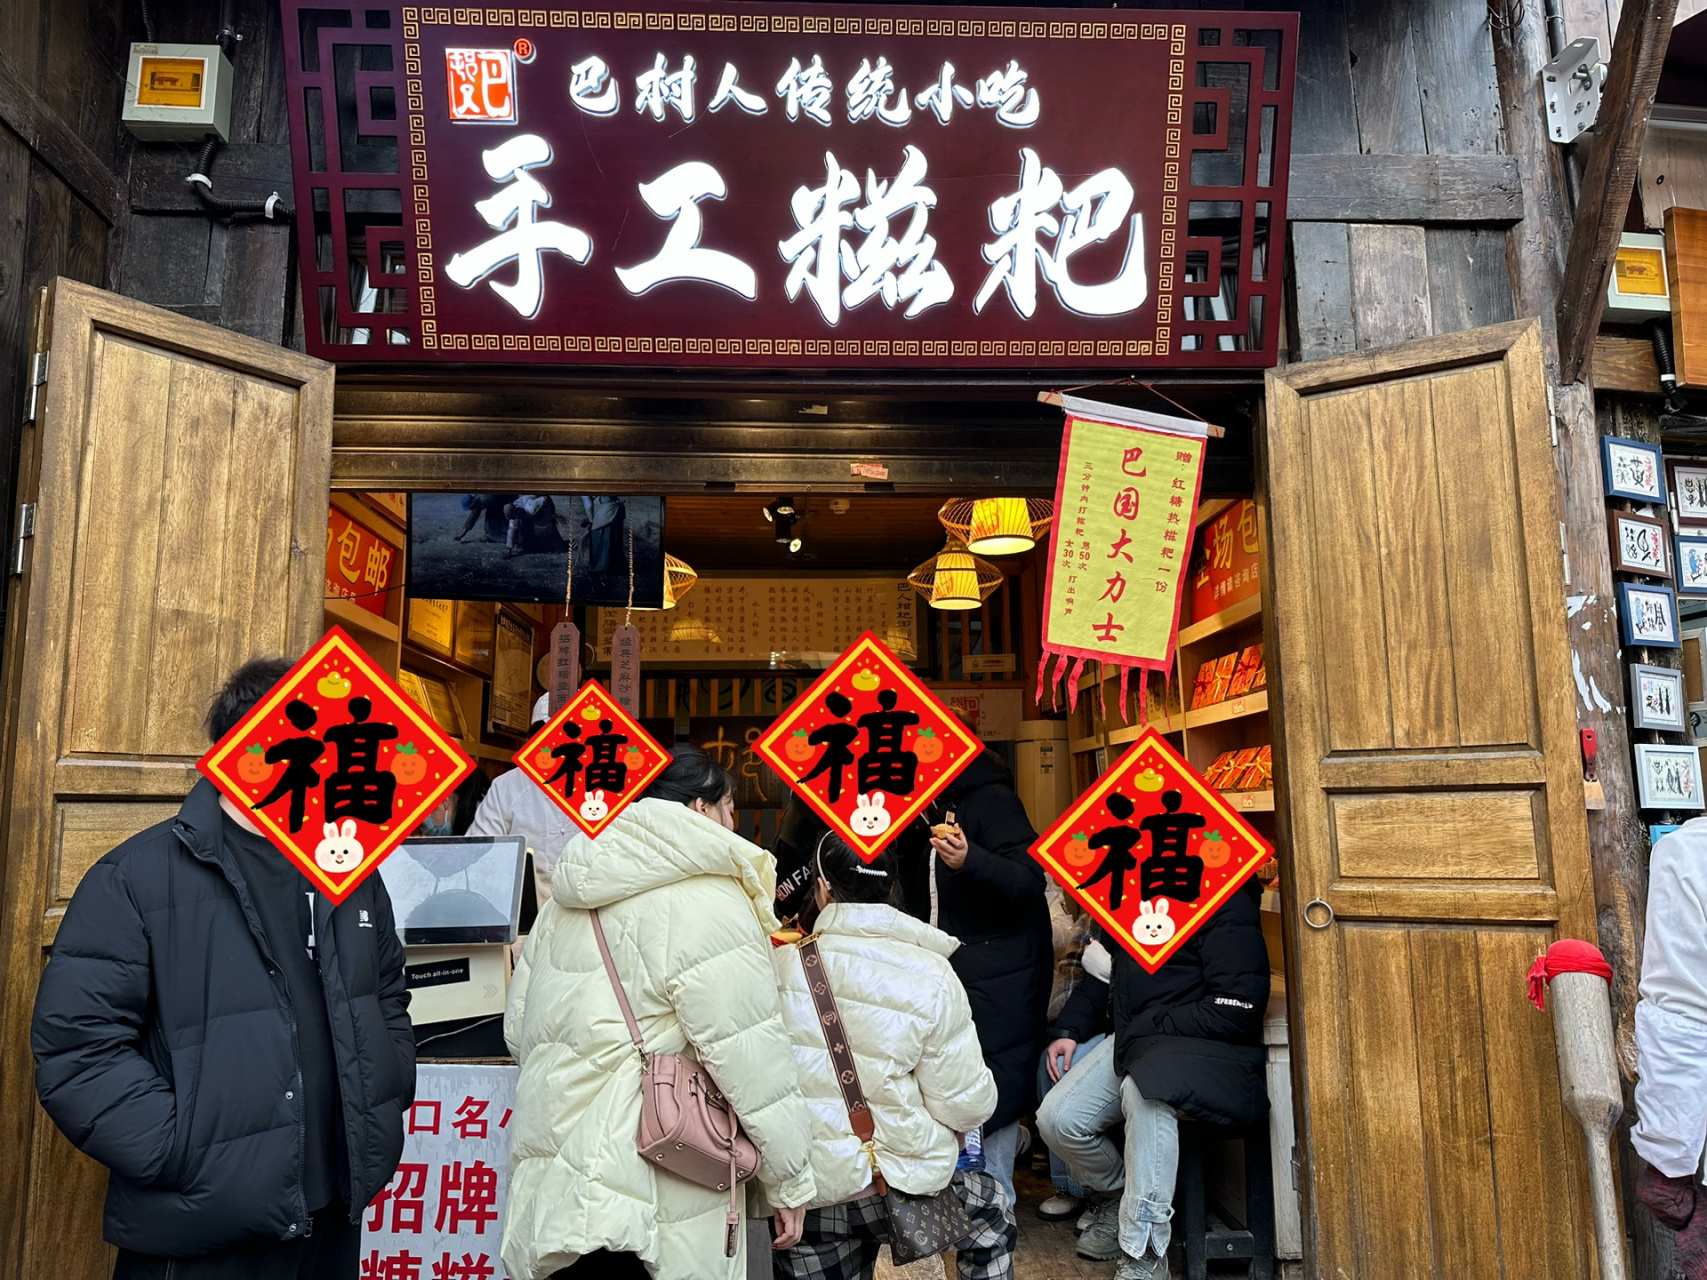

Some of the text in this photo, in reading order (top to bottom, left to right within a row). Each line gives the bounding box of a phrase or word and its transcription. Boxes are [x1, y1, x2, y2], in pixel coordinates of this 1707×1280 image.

[568, 53, 1041, 129] 巴村人传统小吃
[444, 133, 1148, 327] 手工糍粑
[327, 508, 390, 596] 包邮
[1091, 446, 1147, 643] 巴国大力士
[619, 637, 633, 712] 经典芝麻沙糖
[411, 967, 464, 980] Touch all-in-one
[367, 1160, 498, 1235] 招牌
